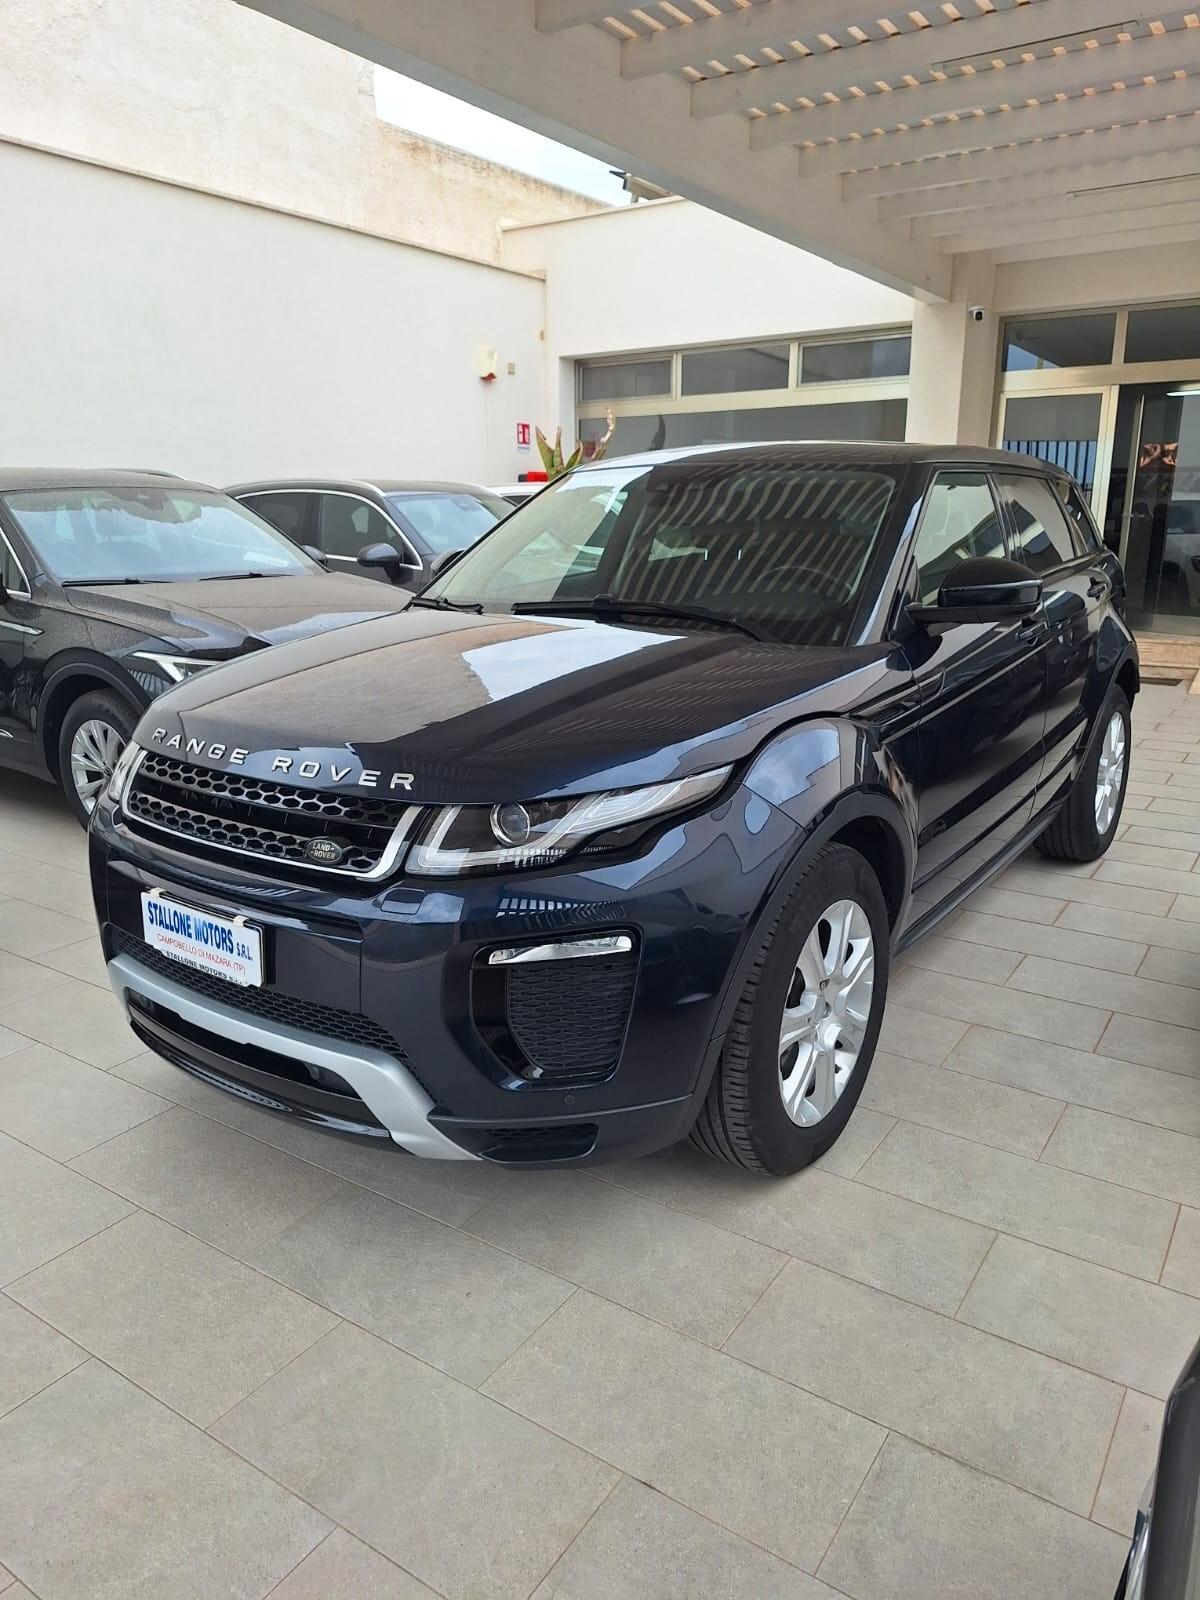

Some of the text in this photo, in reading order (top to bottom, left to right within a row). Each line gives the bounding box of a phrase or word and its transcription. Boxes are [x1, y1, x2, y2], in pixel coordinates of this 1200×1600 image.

[151, 727, 415, 791] RANGE ROVER
[148, 901, 192, 939] STALLONE
[194, 917, 234, 955] MOTORS
[157, 933, 197, 955] CAMPOBELLO
[205, 951, 232, 969] MAZARA
